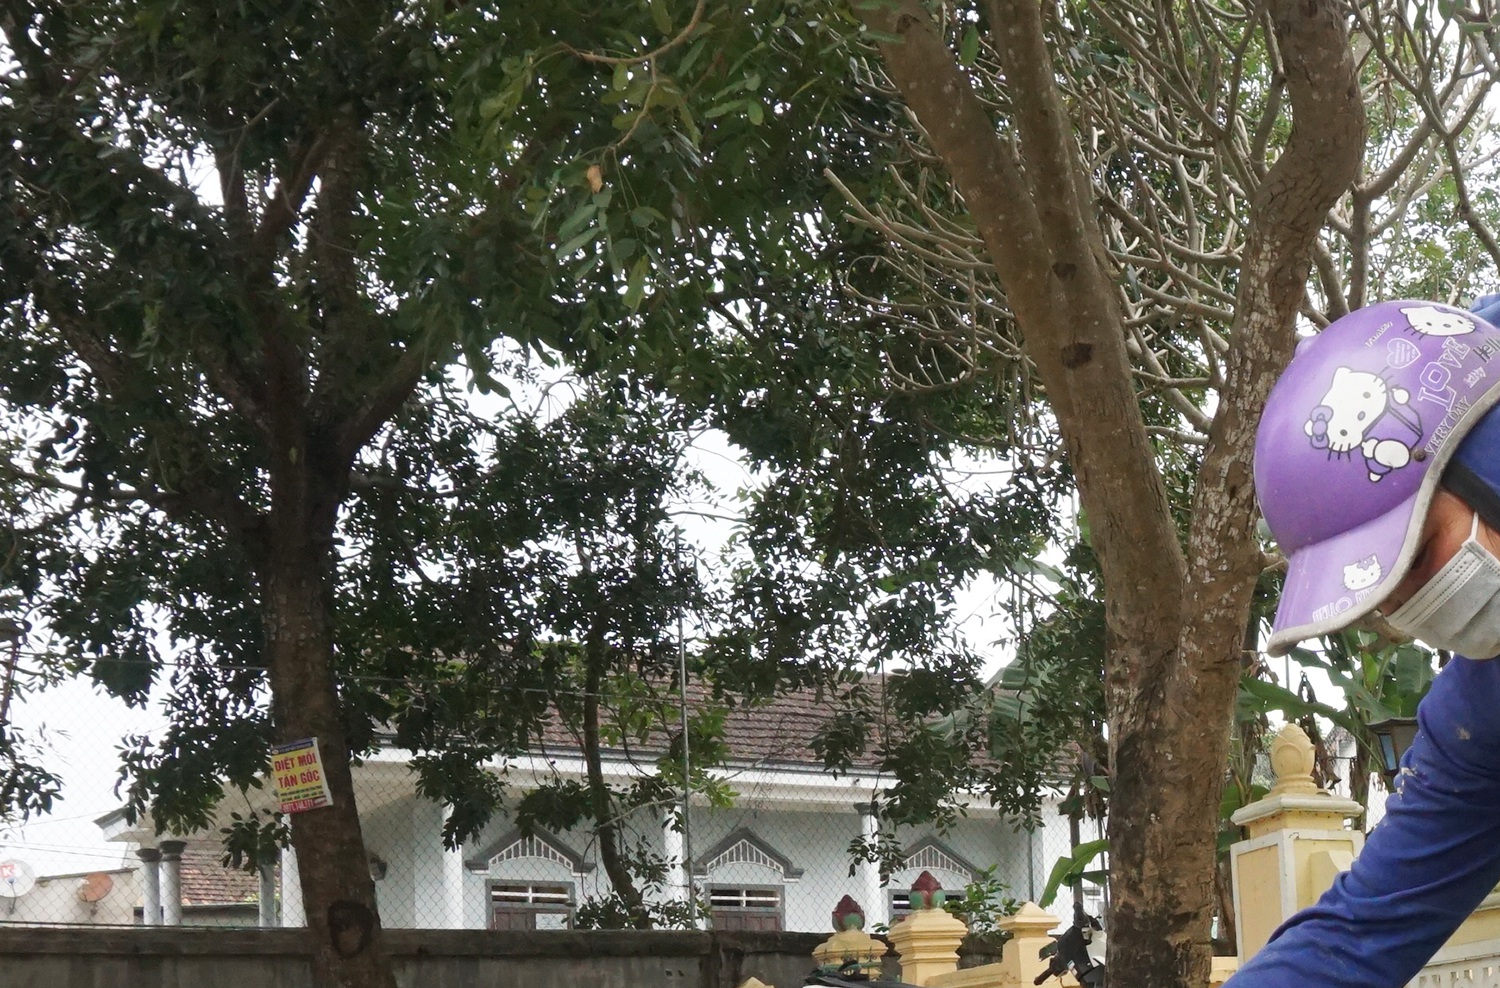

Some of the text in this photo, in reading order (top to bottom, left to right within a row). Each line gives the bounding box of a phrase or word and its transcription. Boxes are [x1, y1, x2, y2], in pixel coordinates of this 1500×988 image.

[1417, 336, 1470, 412] LOVE
[1448, 396, 1472, 423] DAY
[274, 756, 294, 772] DIỆT
[278, 773, 298, 789] TẬN
